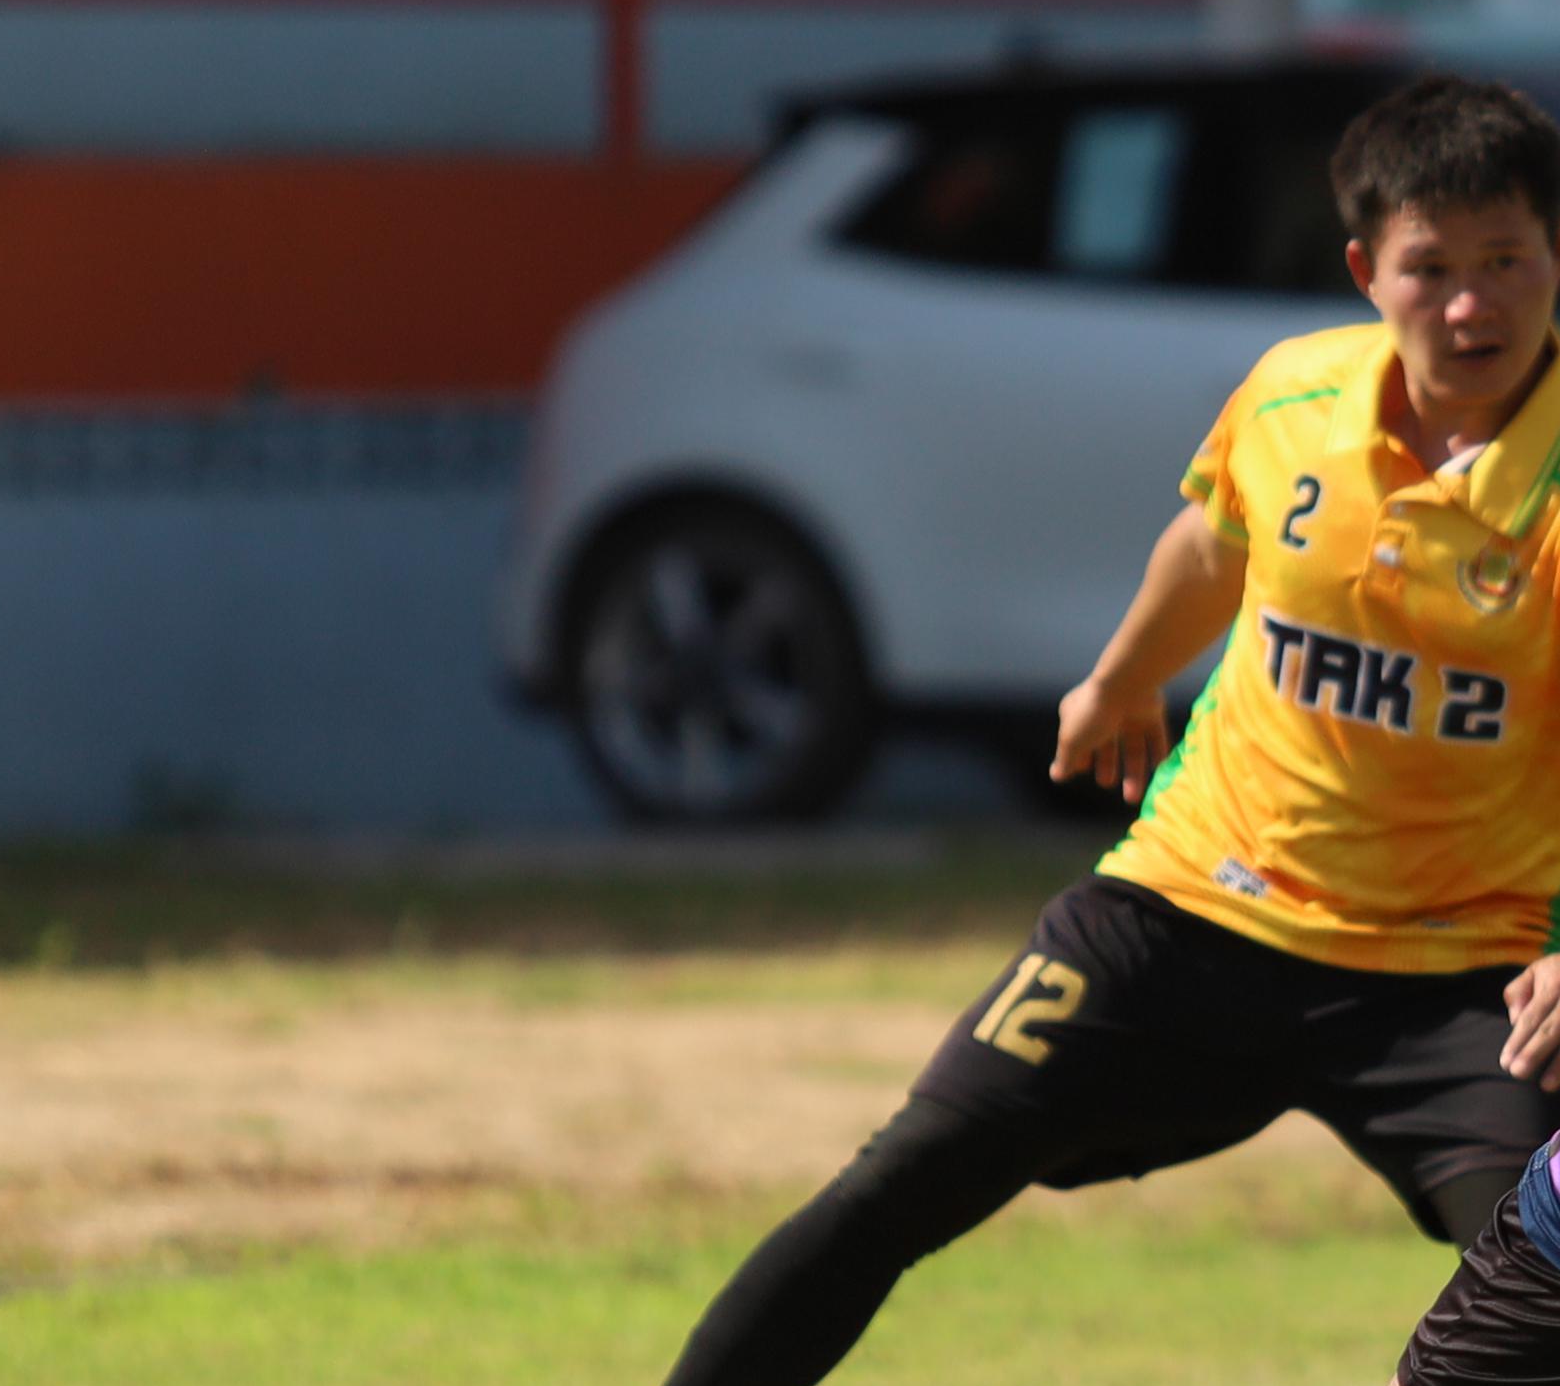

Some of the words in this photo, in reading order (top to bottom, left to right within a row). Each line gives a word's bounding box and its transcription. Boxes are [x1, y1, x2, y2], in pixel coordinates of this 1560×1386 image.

[1279, 473, 1322, 550] 2
[1261, 611, 1418, 734] TAK
[1436, 666, 1508, 743] 2
[971, 952, 1088, 1067] 12
